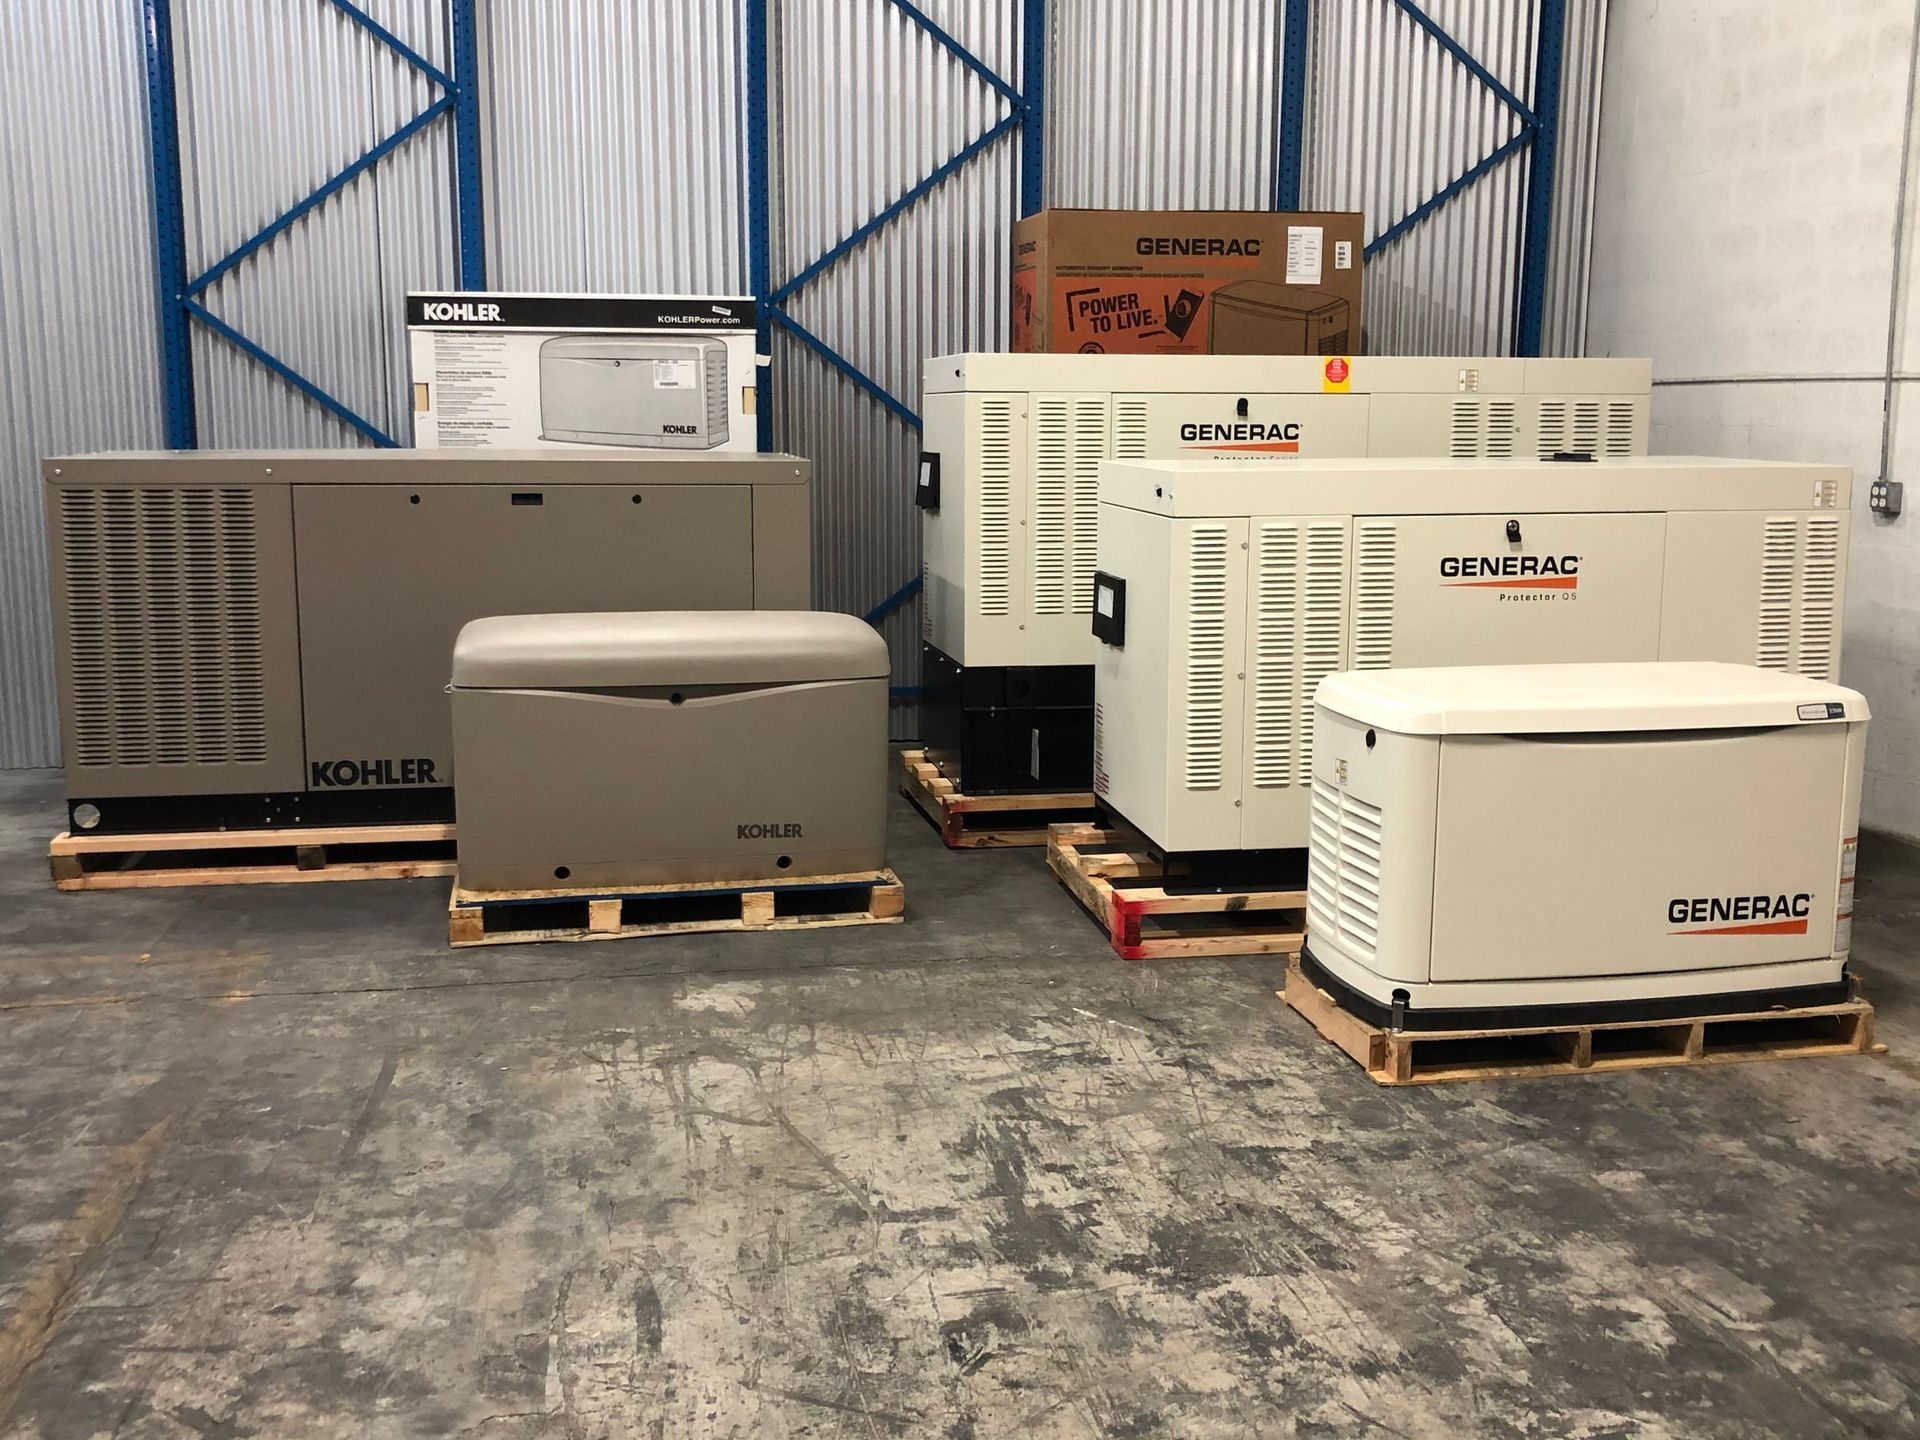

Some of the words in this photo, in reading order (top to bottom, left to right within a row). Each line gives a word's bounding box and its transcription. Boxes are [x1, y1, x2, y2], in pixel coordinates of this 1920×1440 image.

[1136, 237, 1261, 256] GENERAC
[423, 302, 502, 322] KOHLER
[1079, 293, 1139, 318] POWER
[657, 315, 741, 324] KOHLERPower.com
[1090, 316, 1112, 334] TO
[1116, 309, 1158, 330] LIVE.
[662, 424, 699, 435] KOHLER
[1180, 423, 1300, 441] GENERAC
[1440, 555, 1580, 577] GENERAC
[1499, 593, 1556, 602] Protector
[311, 758, 438, 787] KOHLER
[737, 823, 803, 840] KOHLER
[1668, 893, 1811, 923] GENERAC
